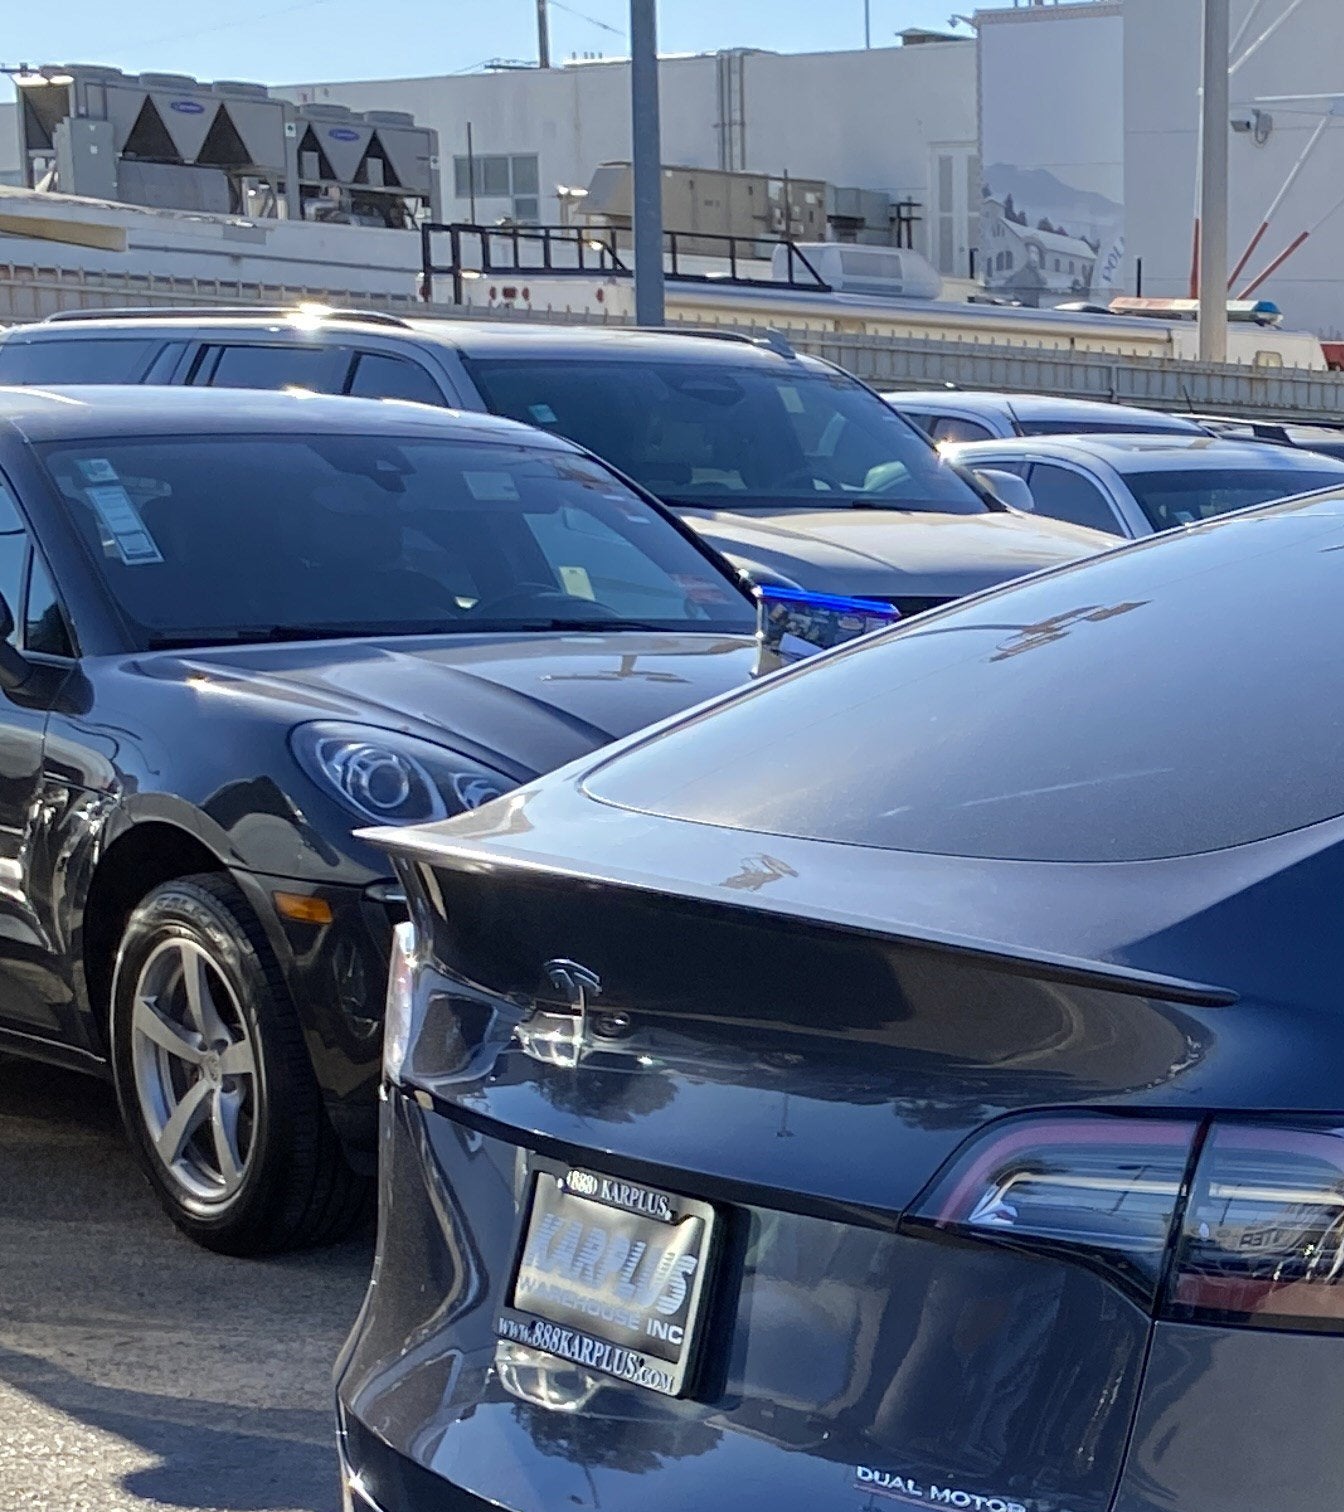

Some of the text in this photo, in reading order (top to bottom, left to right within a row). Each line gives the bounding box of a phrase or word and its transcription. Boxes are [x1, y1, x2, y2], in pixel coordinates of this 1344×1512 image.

[600, 1180, 669, 1215] KARPLUS
[524, 1213, 698, 1315] KARPLUS
[519, 1275, 684, 1345] WAREHOUSE INC
[856, 1466, 922, 1497] DUAL
